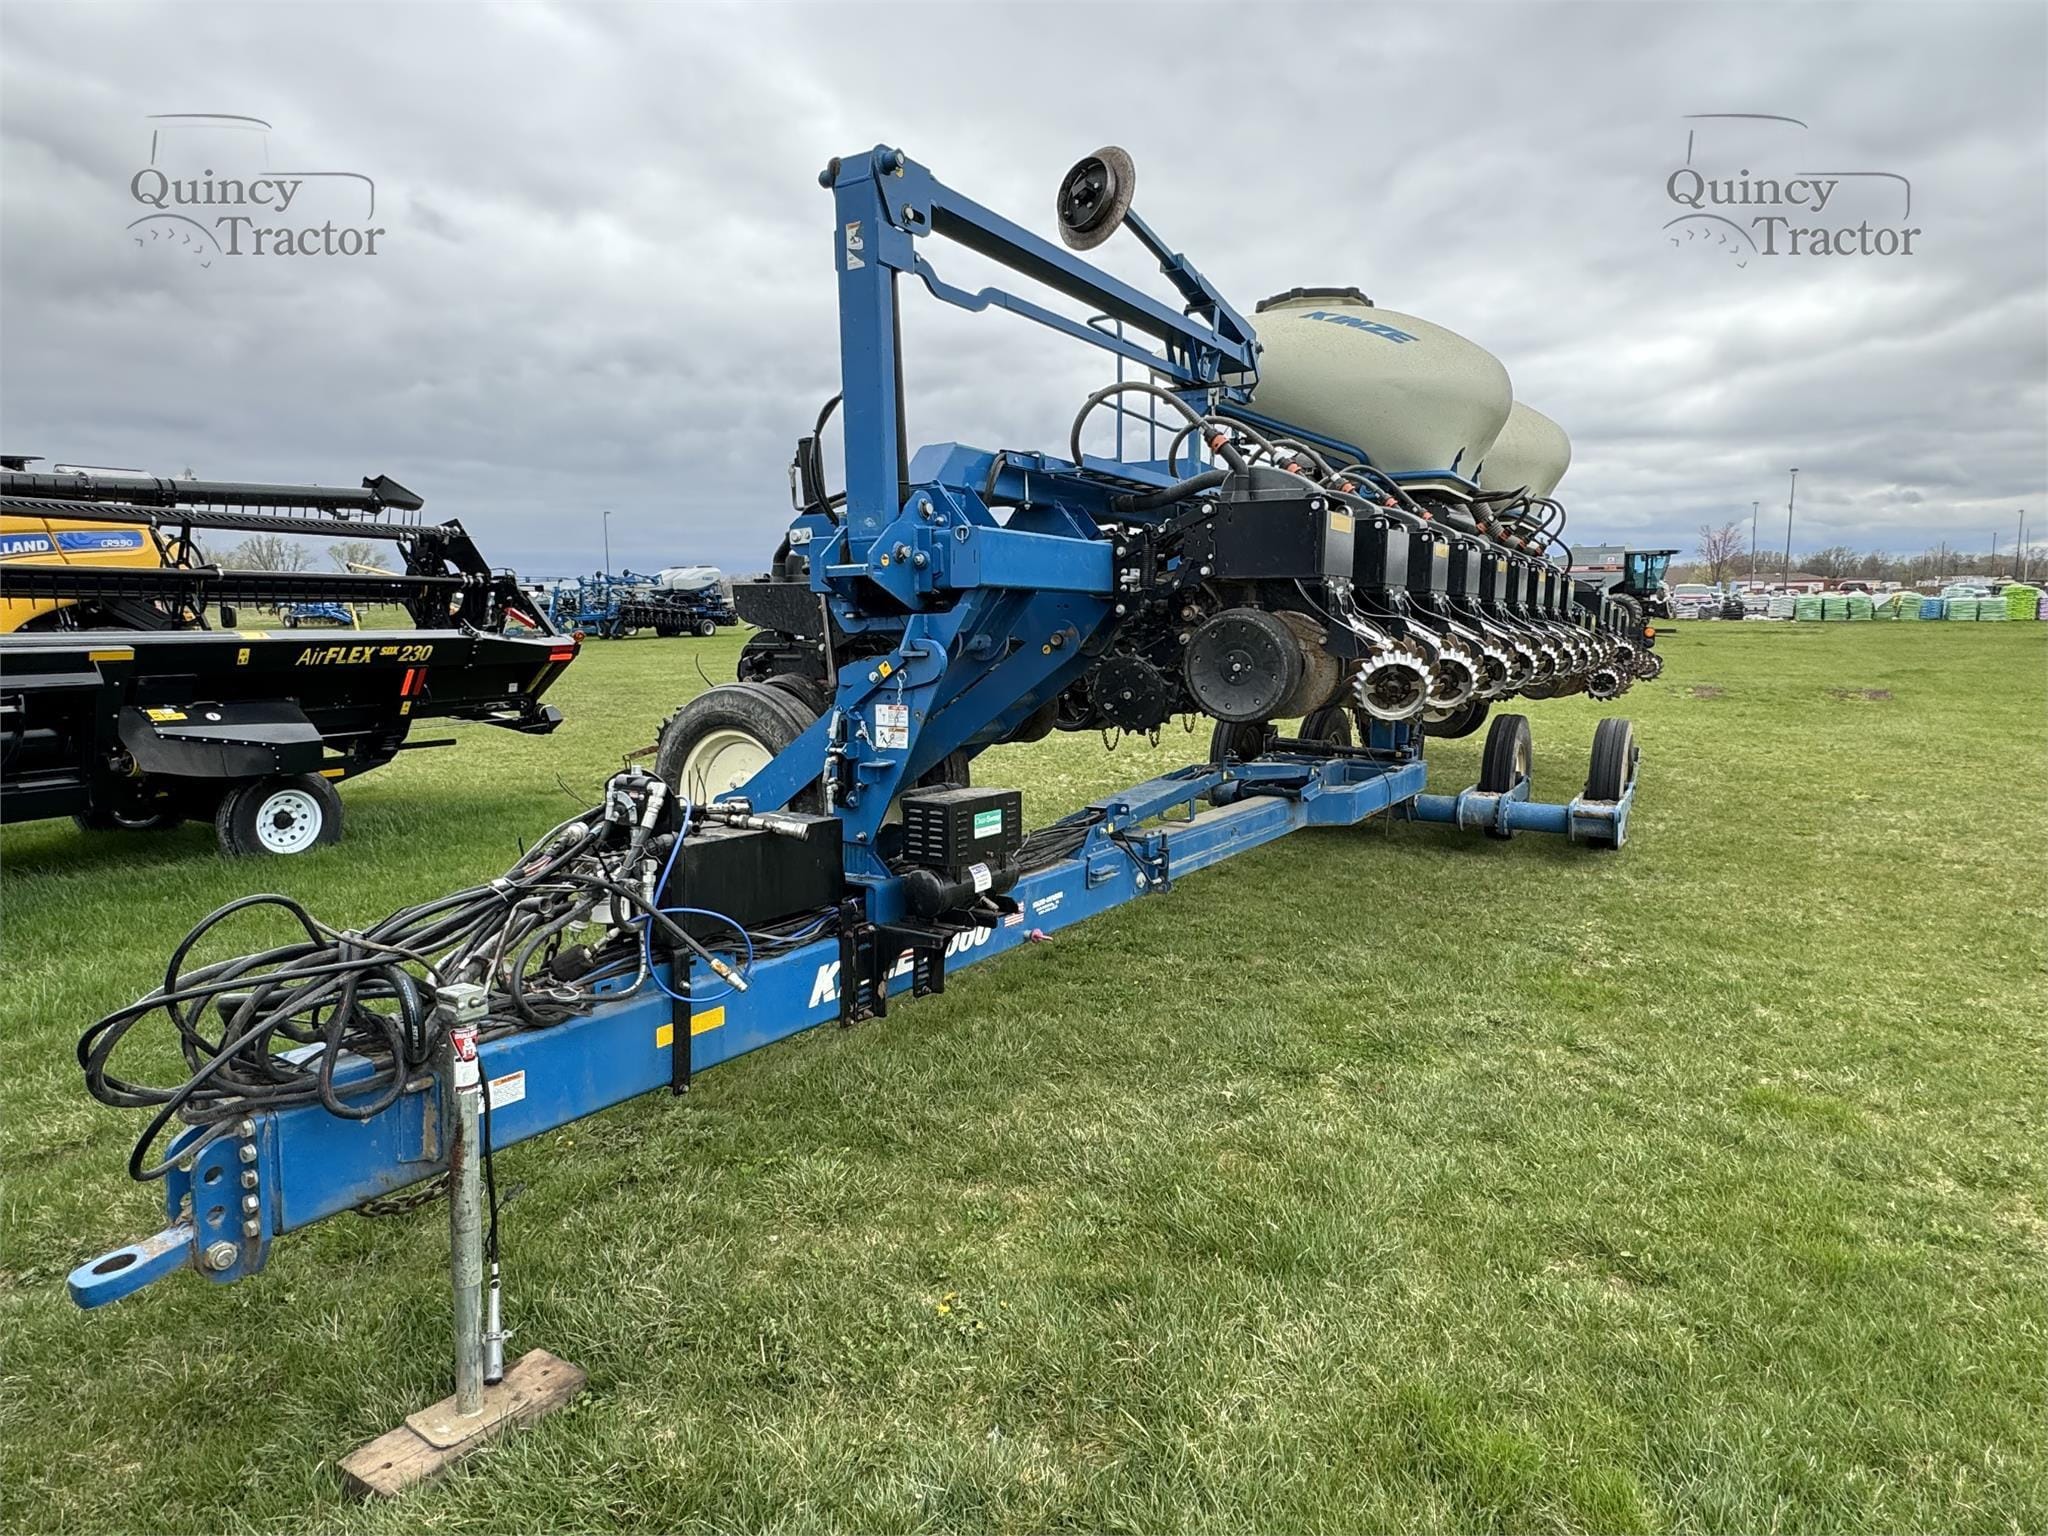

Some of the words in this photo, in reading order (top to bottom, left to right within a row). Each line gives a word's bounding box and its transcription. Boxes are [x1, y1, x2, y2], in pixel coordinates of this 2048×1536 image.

[1298, 310, 1421, 344] KINZE
[0, 539, 49, 556] LAND
[294, 646, 377, 666] AirFLEX
[397, 644, 434, 662] 230
